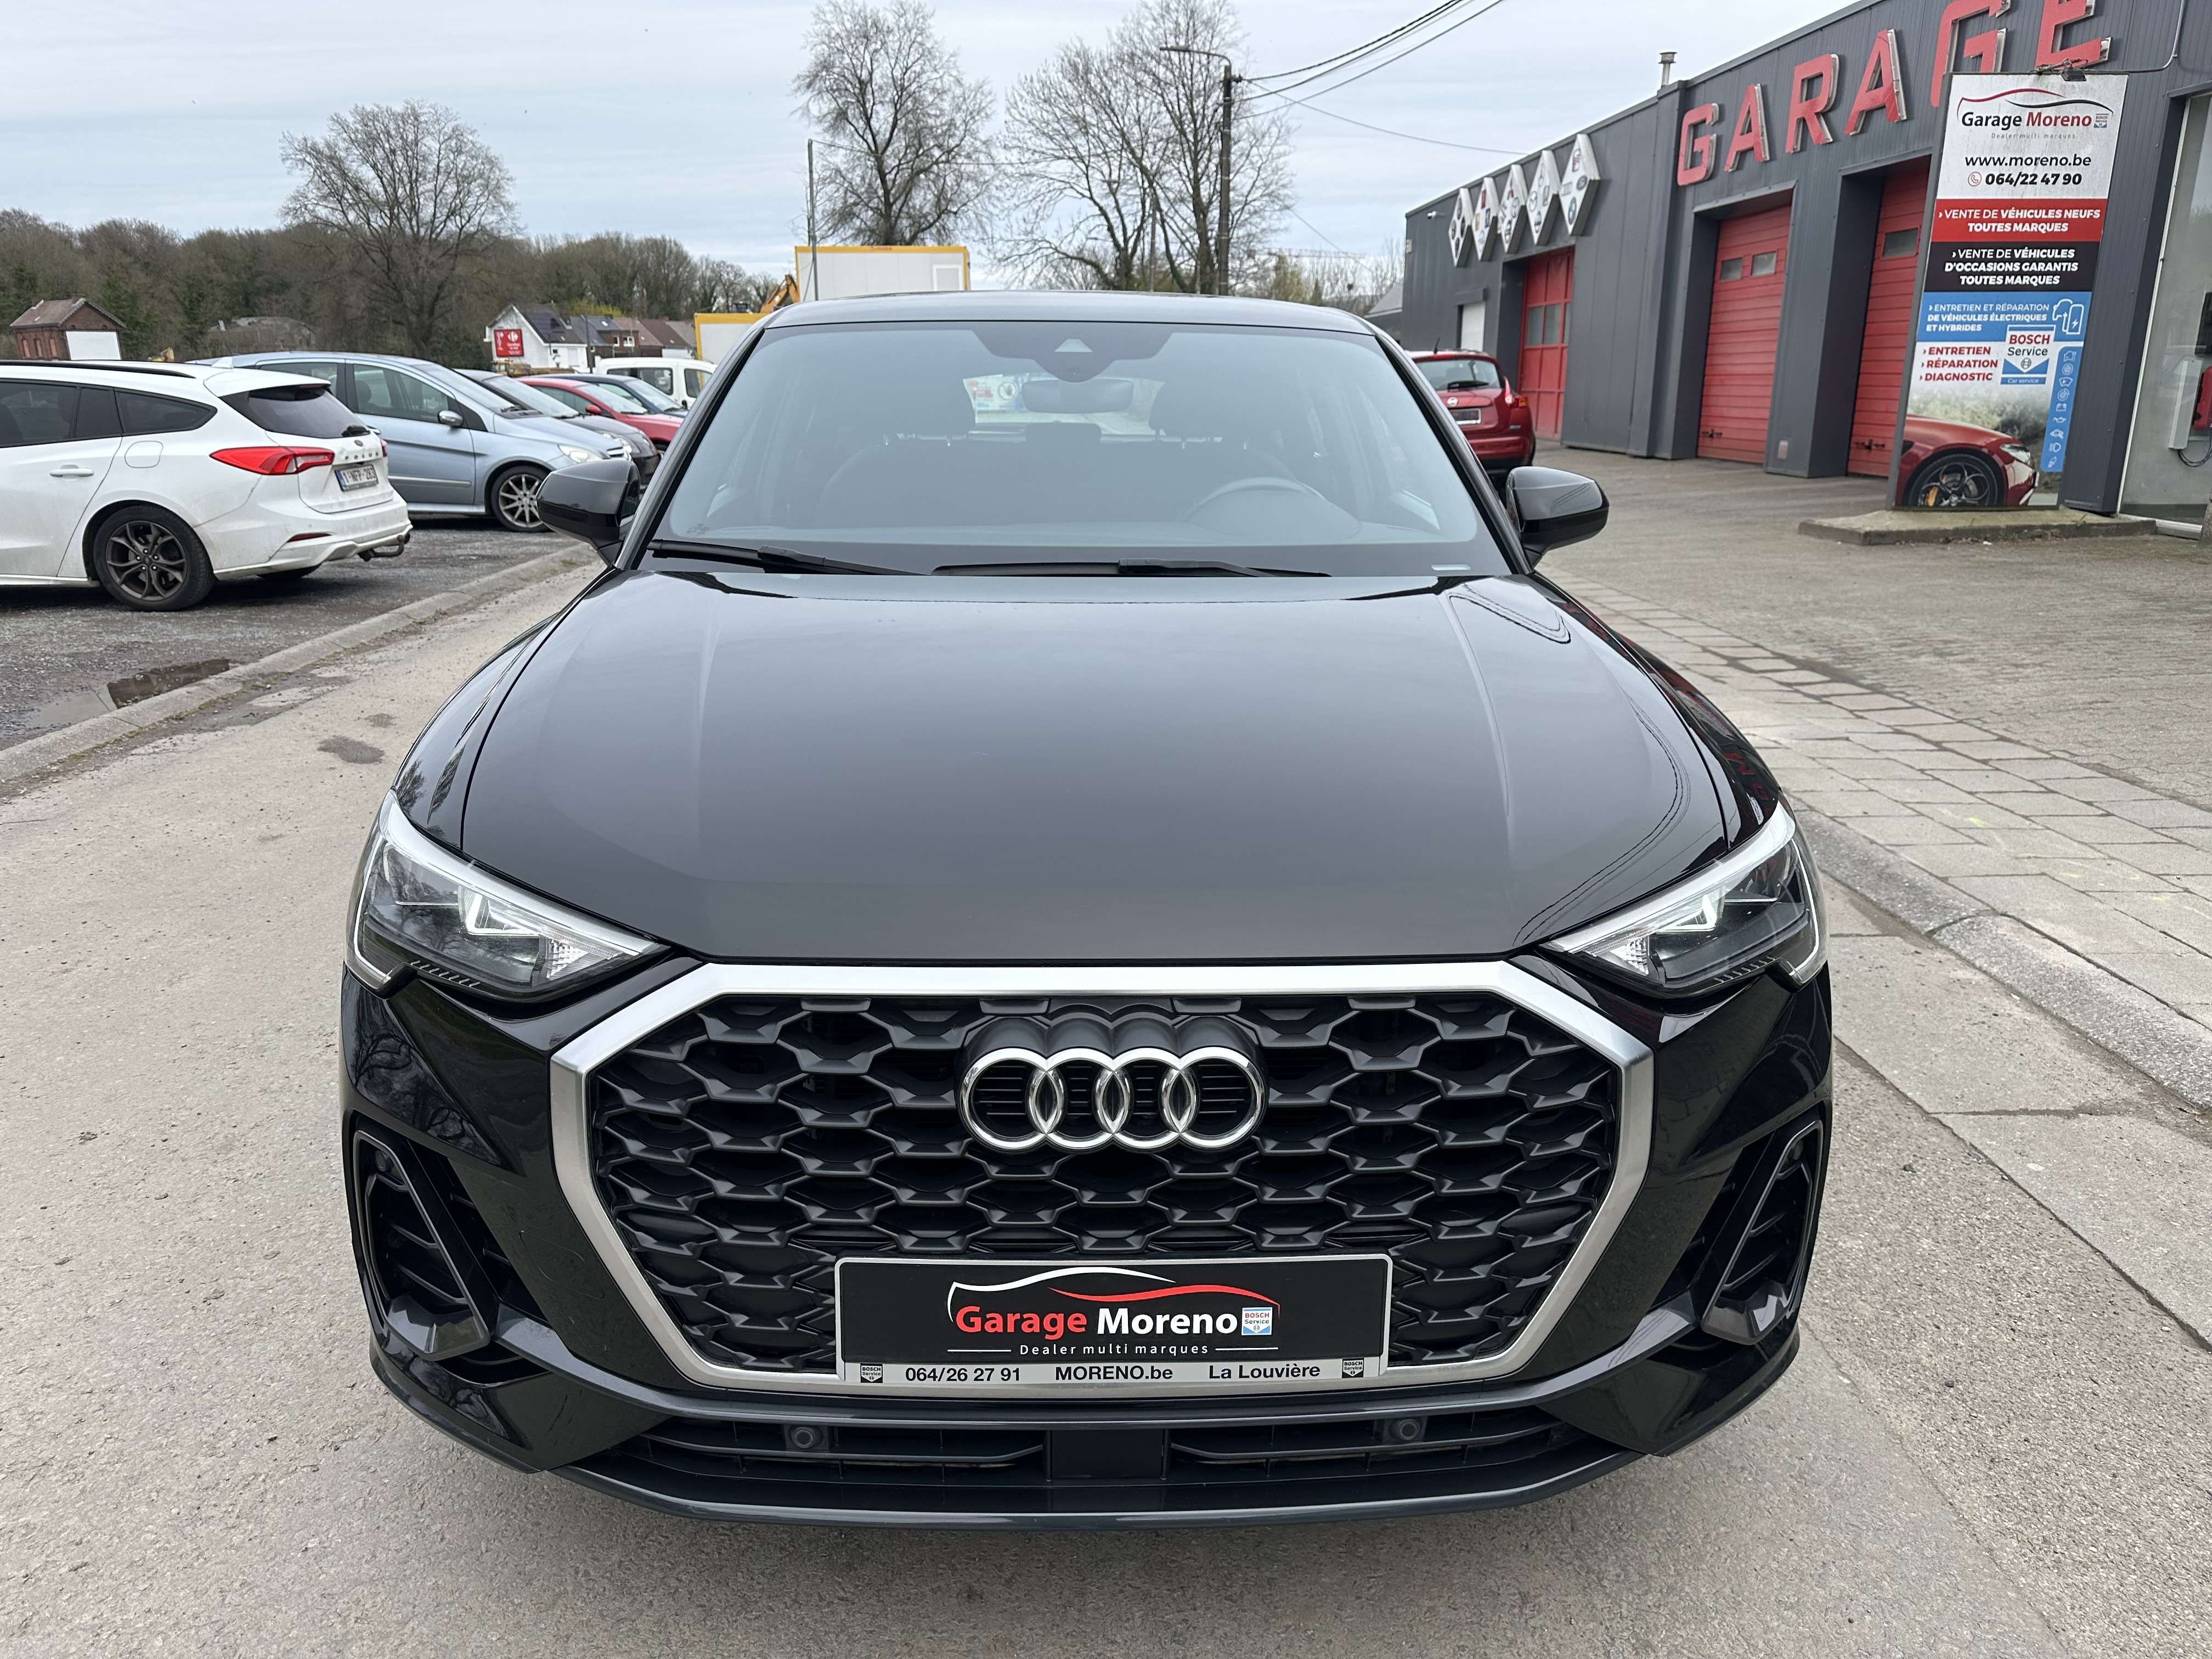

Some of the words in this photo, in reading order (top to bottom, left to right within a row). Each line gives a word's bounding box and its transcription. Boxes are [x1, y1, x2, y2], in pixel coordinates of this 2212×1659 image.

[1677, 0, 2111, 185] GARAGE
[1962, 111, 2022, 130] Garage
[2026, 111, 2092, 127] Moreno
[1965, 154, 2091, 166] www.moreno.be
[1985, 172, 2037, 187] 064/22
[2041, 173, 2060, 185] 47
[2062, 173, 2082, 185] 90
[1945, 210, 1980, 218] VENTE
[1983, 210, 1998, 218] DE
[2001, 207, 2062, 218] VÉHICULES
[2063, 210, 2100, 218] NEUFS
[1968, 223, 2011, 232] TOUTES
[2013, 223, 2069, 233] MARQUES
[1958, 249, 1993, 258] VENTE
[1996, 249, 2011, 258] DE
[2013, 247, 2075, 258] VÉHICULES
[2022, 262, 2078, 272] GARANTIS
[1960, 275, 2003, 285] TOUTES
[2005, 275, 2060, 286] MARQUES
[1996, 302, 2049, 311] RÉPARATION
[1941, 313, 1988, 321] VÉHICULES
[1990, 313, 2047, 322] ÉLECTRIQUES
[2009, 335, 2050, 345] BOSCH
[1928, 347, 1991, 355] ENTRETIEN
[2007, 347, 2048, 356] Service
[1926, 358, 1998, 368] RÉPARATION
[956, 1306, 1087, 1340] Garage
[1097, 1308, 1238, 1334] Moreno
[1020, 1344, 1076, 1355] Dealer
[1083, 1344, 1127, 1354] multi
[1135, 1345, 1208, 1356] marques
[905, 1367, 968, 1382] 064/26
[974, 1368, 995, 1381] 27
[1001, 1368, 1020, 1381] 91
[1056, 1365, 1173, 1380] MORENO.be
[1209, 1365, 1232, 1379] La
[1239, 1364, 1320, 1379] Louvière
